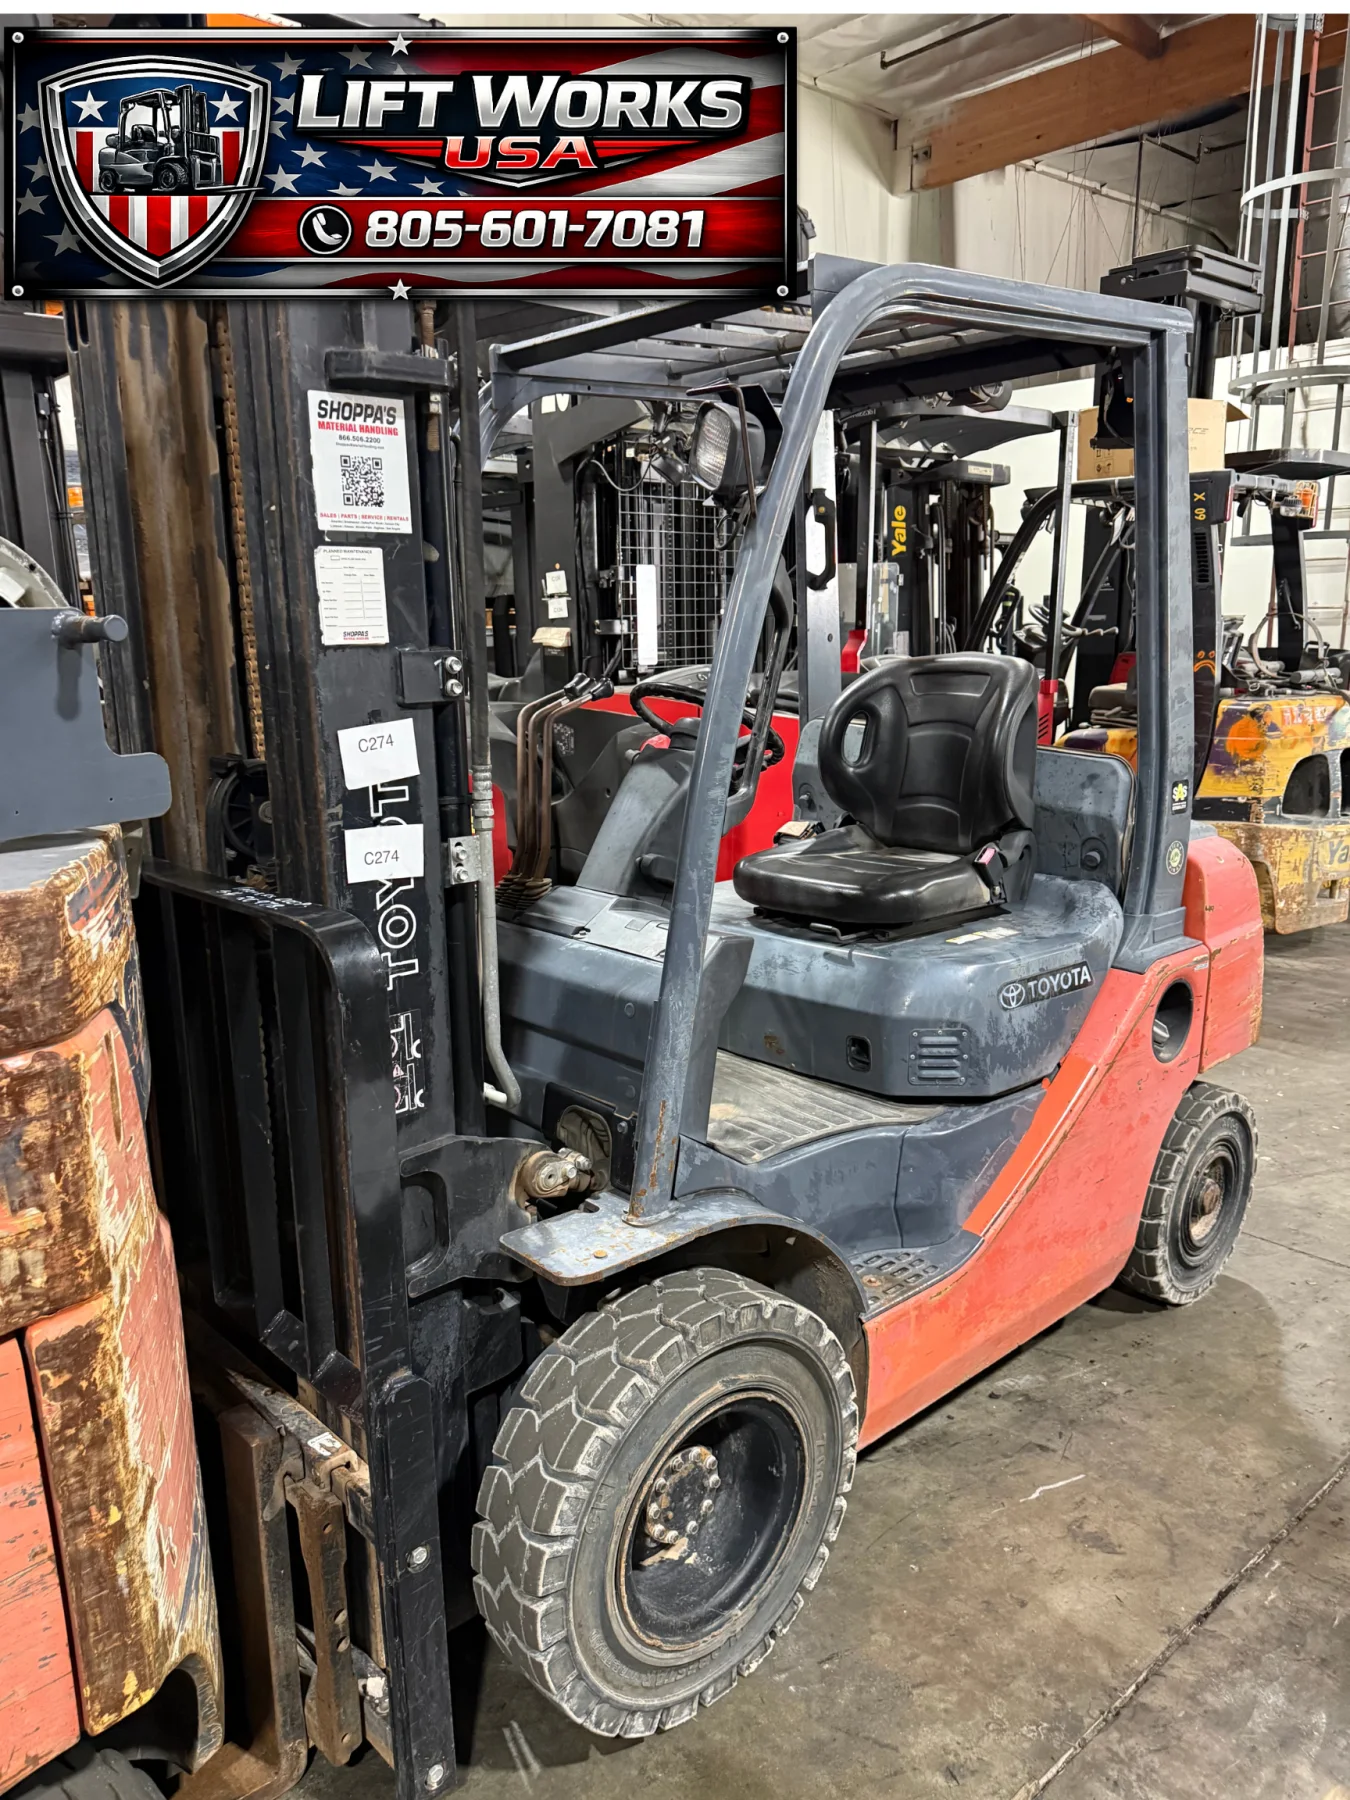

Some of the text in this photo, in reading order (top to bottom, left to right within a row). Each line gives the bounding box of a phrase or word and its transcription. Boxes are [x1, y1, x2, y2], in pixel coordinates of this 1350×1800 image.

[317, 399, 397, 425] SHOPPA'S
[317, 420, 399, 436] MATERIAL HANDLING
[1193, 491, 1206, 502] X
[891, 505, 907, 556] Yale
[358, 734, 394, 752] C274
[364, 850, 400, 865] C274
[1028, 965, 1092, 998] TOYOTA
